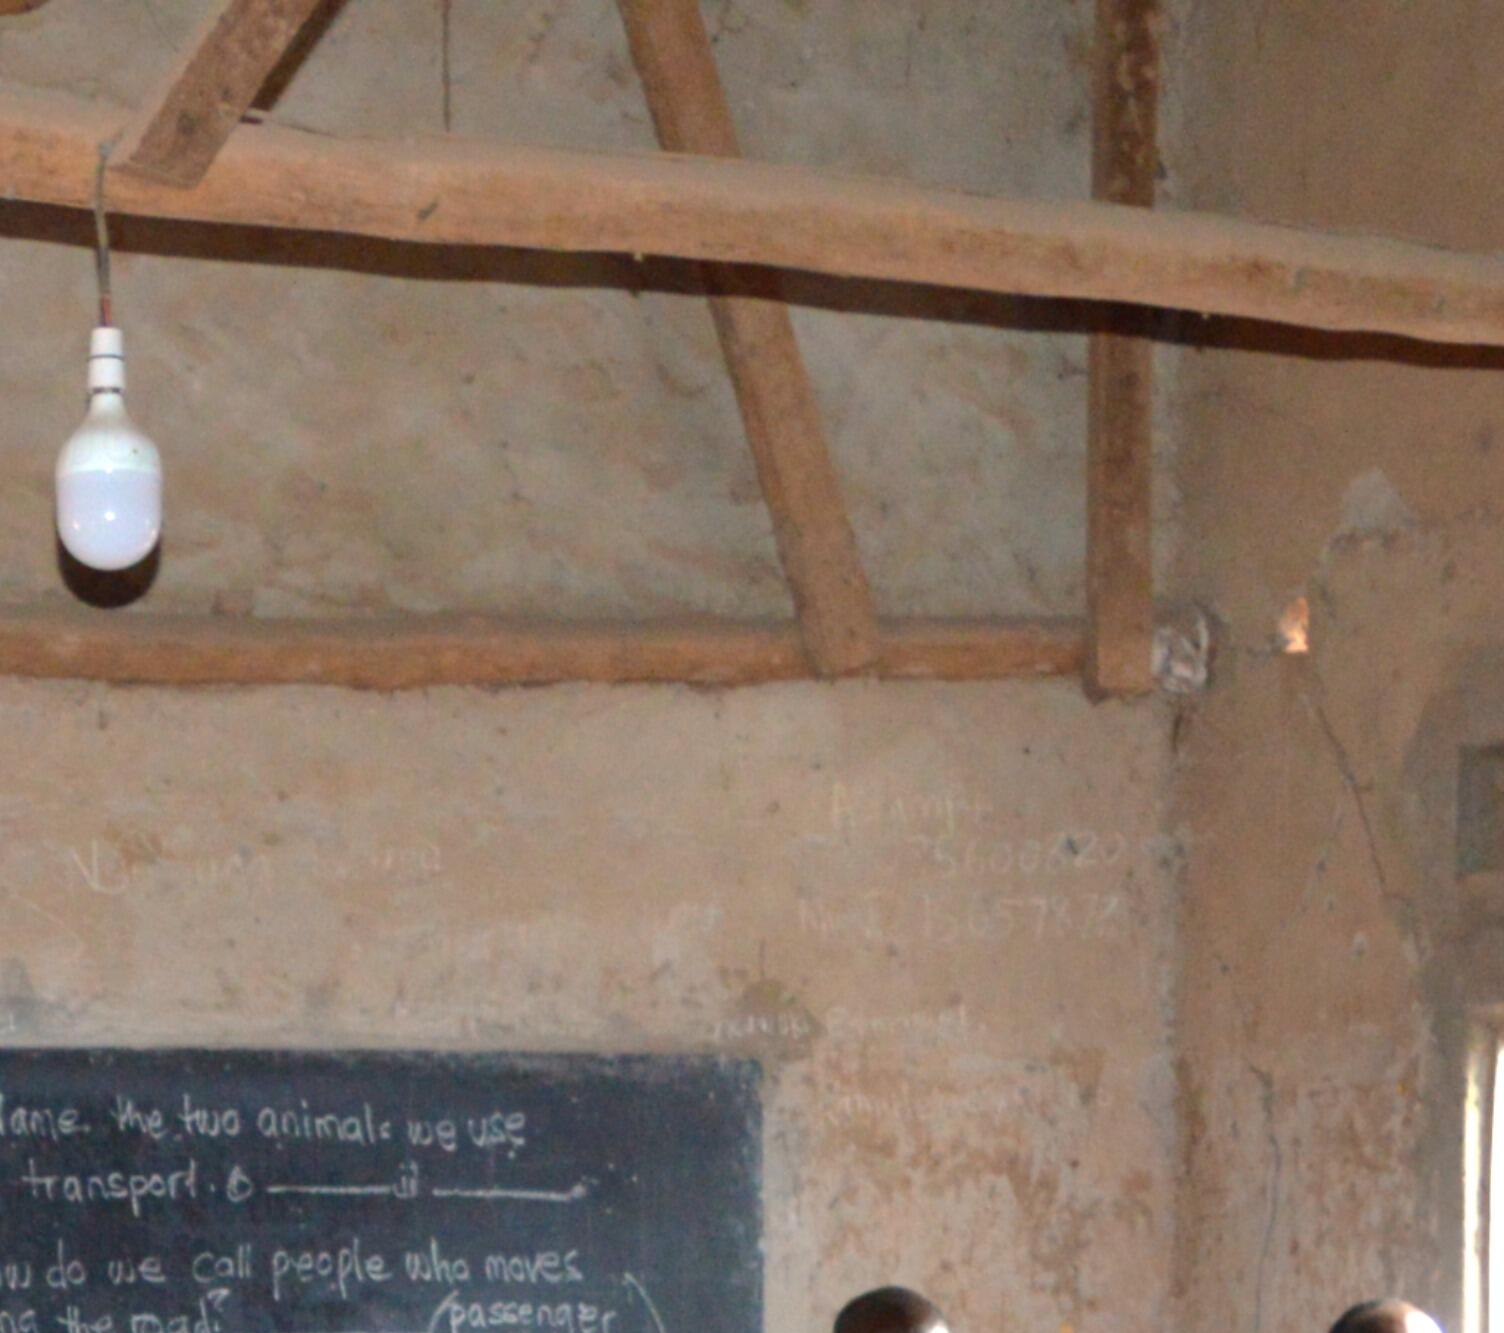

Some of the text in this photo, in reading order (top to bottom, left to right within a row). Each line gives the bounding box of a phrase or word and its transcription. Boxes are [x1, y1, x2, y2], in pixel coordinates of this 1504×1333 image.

[110, 1094, 166, 1140] the
[180, 1092, 242, 1137] two
[256, 1098, 391, 1144] animals
[407, 1117, 458, 1151] we
[467, 1111, 527, 1148] use
[45, 1237, 88, 1289] do
[107, 1256, 168, 1286] we
[191, 1244, 252, 1284] call
[271, 1237, 394, 1302] people
[404, 1236, 471, 1285] who
[484, 1248, 585, 1285] moves
